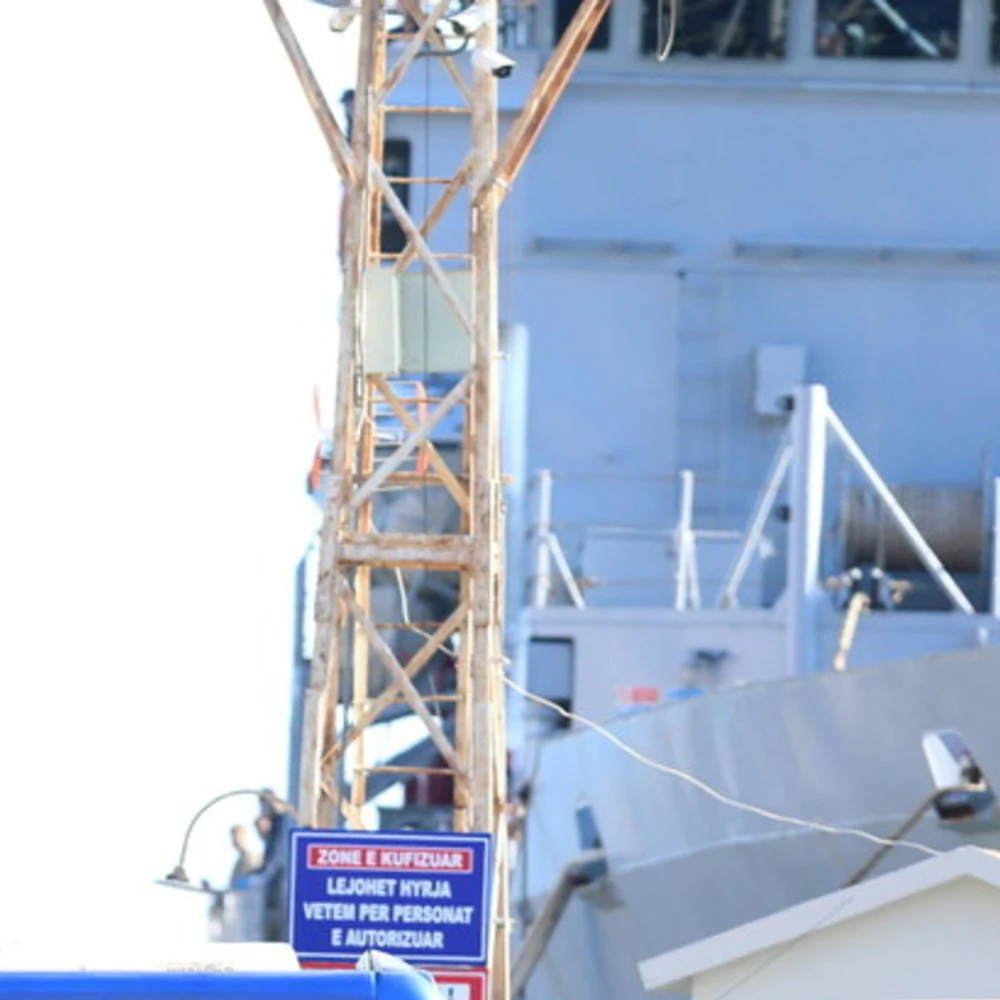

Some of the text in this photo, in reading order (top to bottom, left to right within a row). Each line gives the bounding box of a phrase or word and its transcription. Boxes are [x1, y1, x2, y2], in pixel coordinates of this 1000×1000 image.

[316, 848, 463, 868] ZONE E KUFIZUAR
[327, 877, 451, 899] LEJOHET HYRJA
[303, 902, 474, 924] VETEM PER PERSONAT
[331, 928, 443, 948] E AUTORIZUAR
